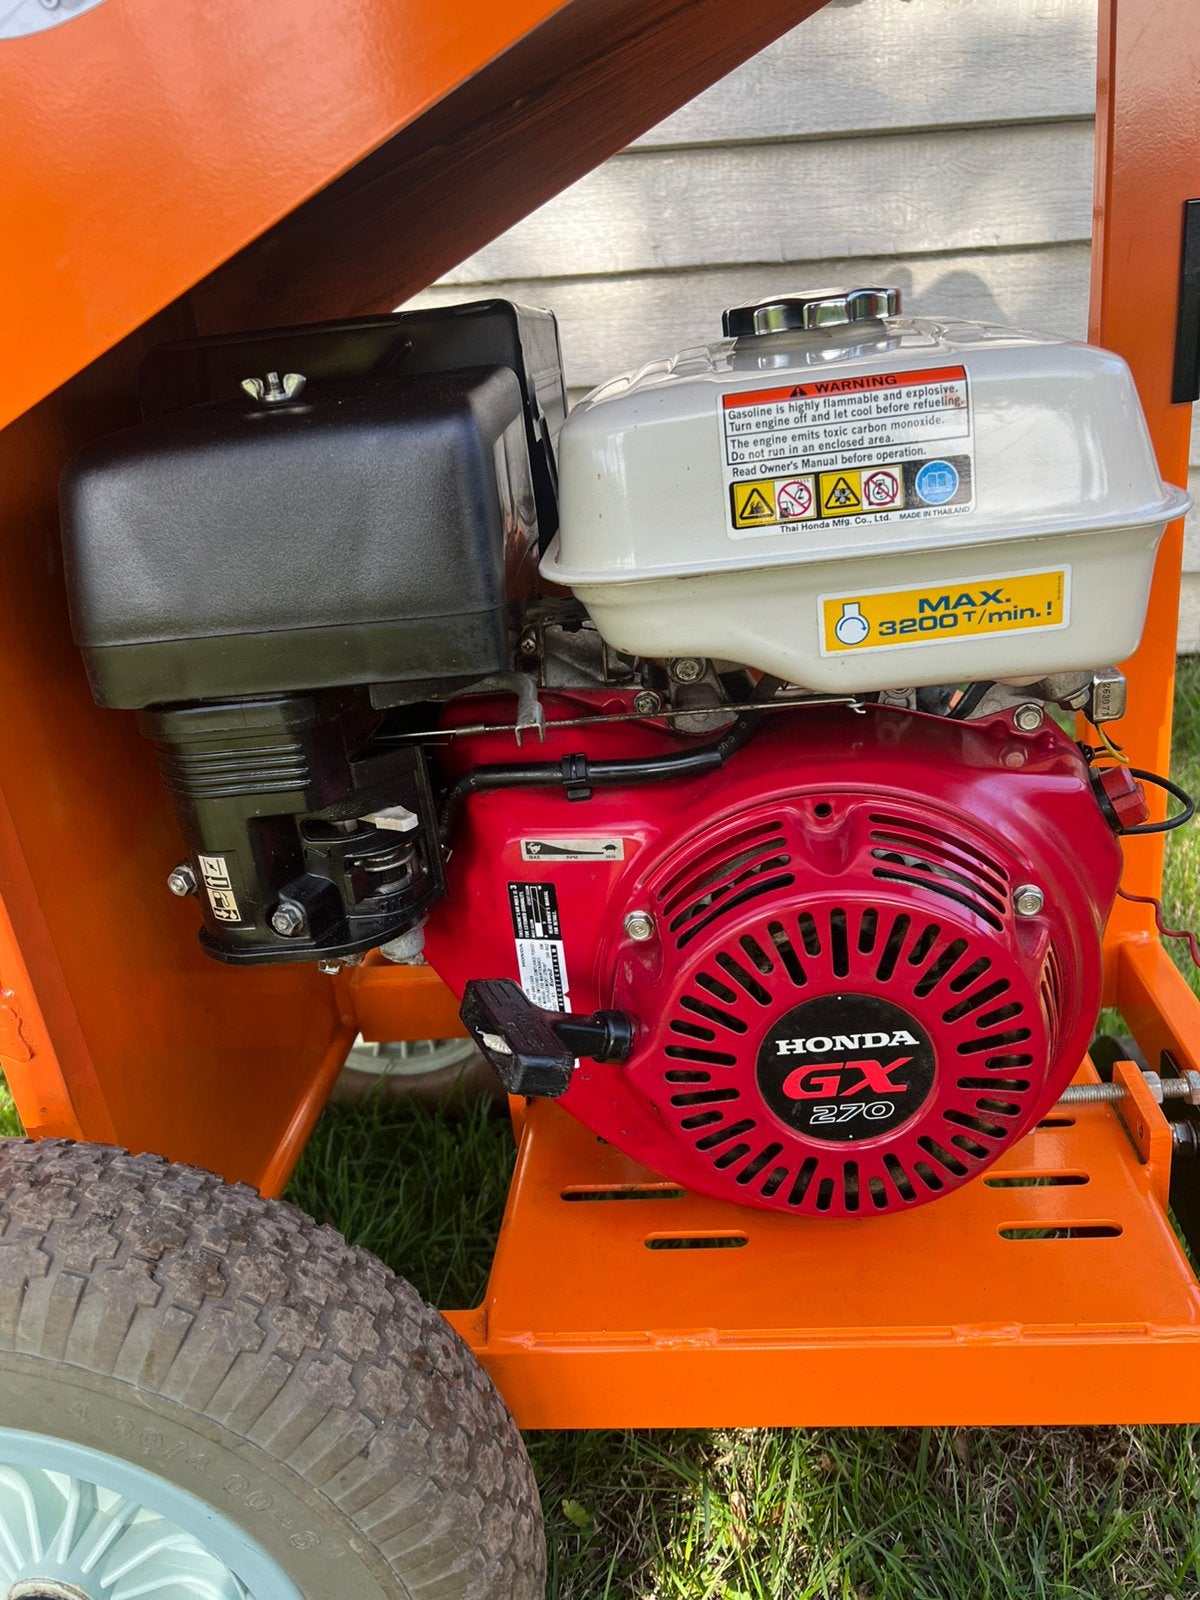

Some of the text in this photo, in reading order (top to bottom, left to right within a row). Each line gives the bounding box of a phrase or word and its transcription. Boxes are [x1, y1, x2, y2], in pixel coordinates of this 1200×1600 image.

[815, 375, 897, 393] WARNING
[728, 384, 959, 420] Gasoline is highly flammable and explosive.
[729, 396, 965, 432] Turn engine off and let cool before refueling.
[730, 416, 945, 450] The engine emits toxic carbon monoxide.
[731, 435, 894, 461] Do not run in an enclosed area.
[732, 446, 927, 477] Read Owner's Manual before operation.
[780, 514, 892, 534] Thai Honda Mfg. Co., Ltd.
[900, 506, 970, 520] MADE IN THAILAND
[918, 588, 1012, 614] MAX.
[775, 1030, 920, 1055] HONDA
[782, 1056, 915, 1100] GX
[809, 1100, 895, 1125] 270
